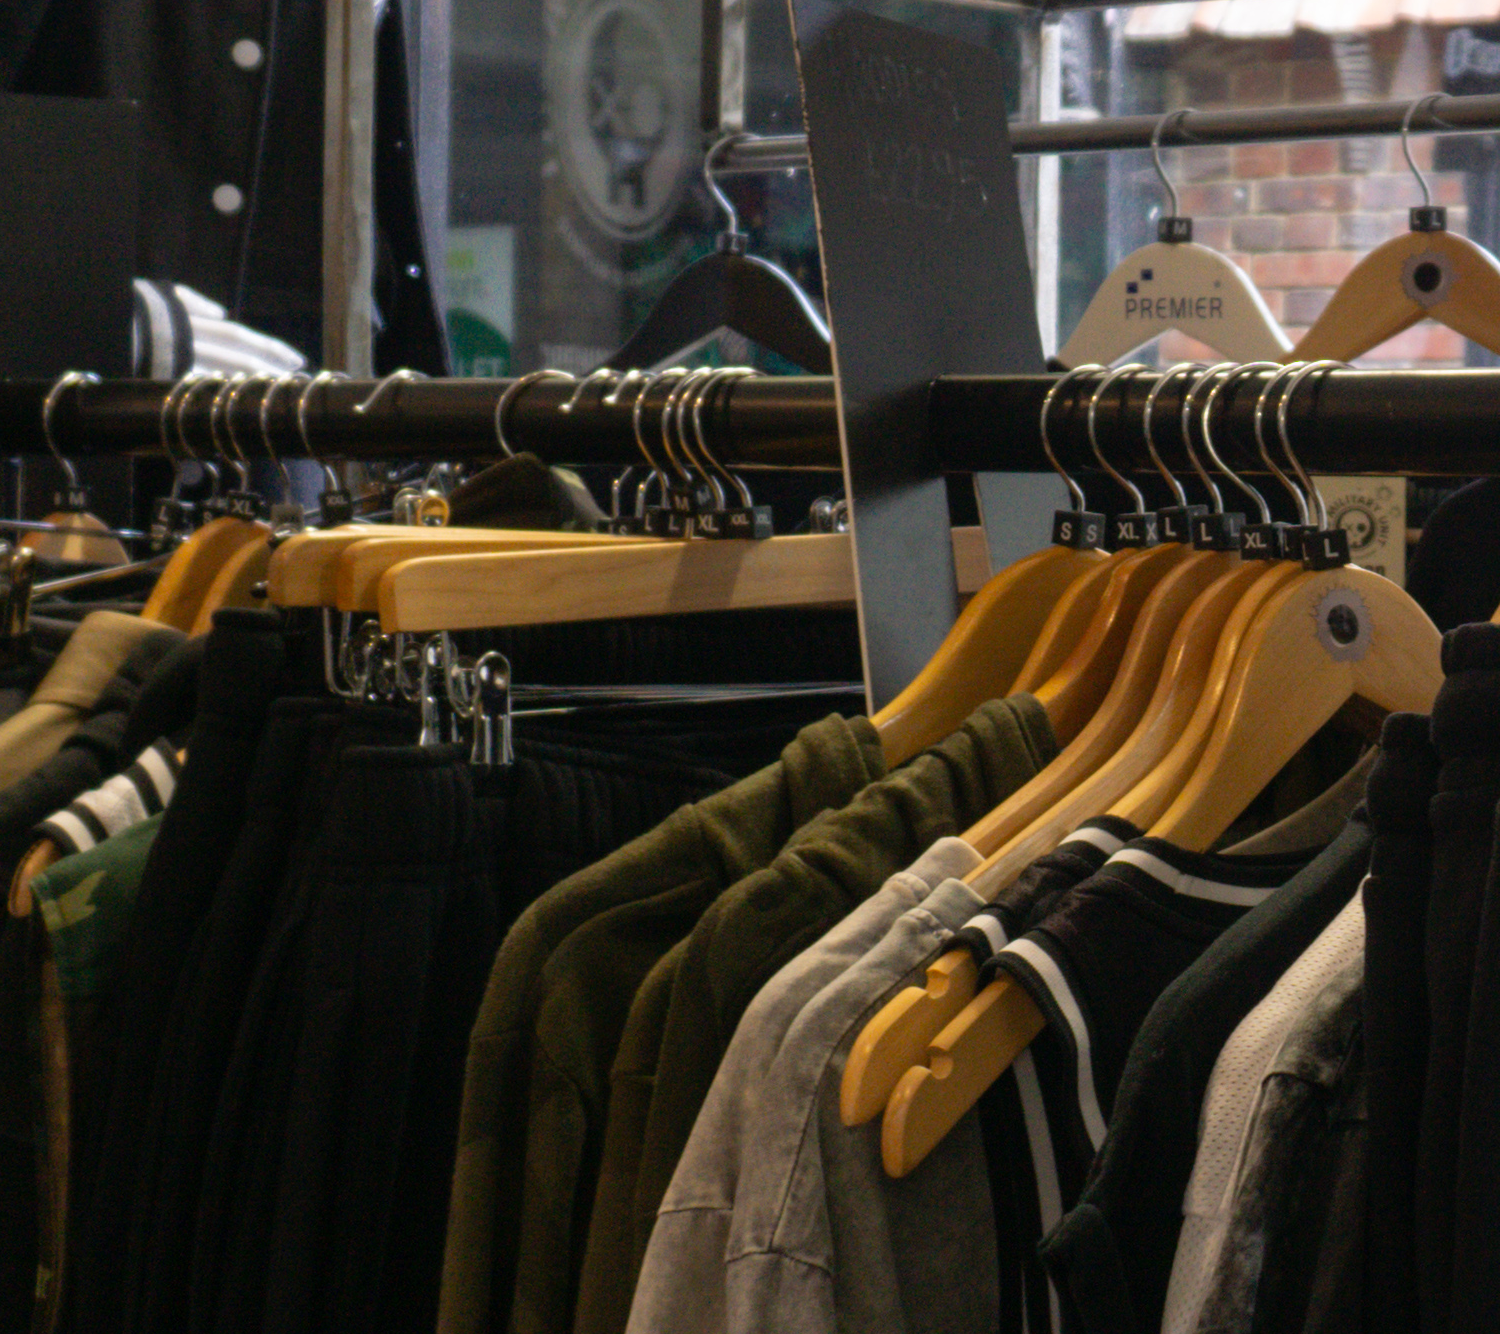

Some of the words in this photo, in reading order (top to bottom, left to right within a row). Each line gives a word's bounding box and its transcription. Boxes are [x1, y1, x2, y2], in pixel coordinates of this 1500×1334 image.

[1125, 296, 1223, 319] PREMIER
[231, 498, 255, 517] XL
[698, 515, 719, 532] XL
[1060, 522, 1072, 541] S
[1117, 522, 1140, 541] XL
[1165, 517, 1177, 537] L
[1201, 522, 1213, 542] L
[1086, 524, 1098, 543] S
[1244, 532, 1267, 549] XL
[1324, 538, 1339, 558] L
